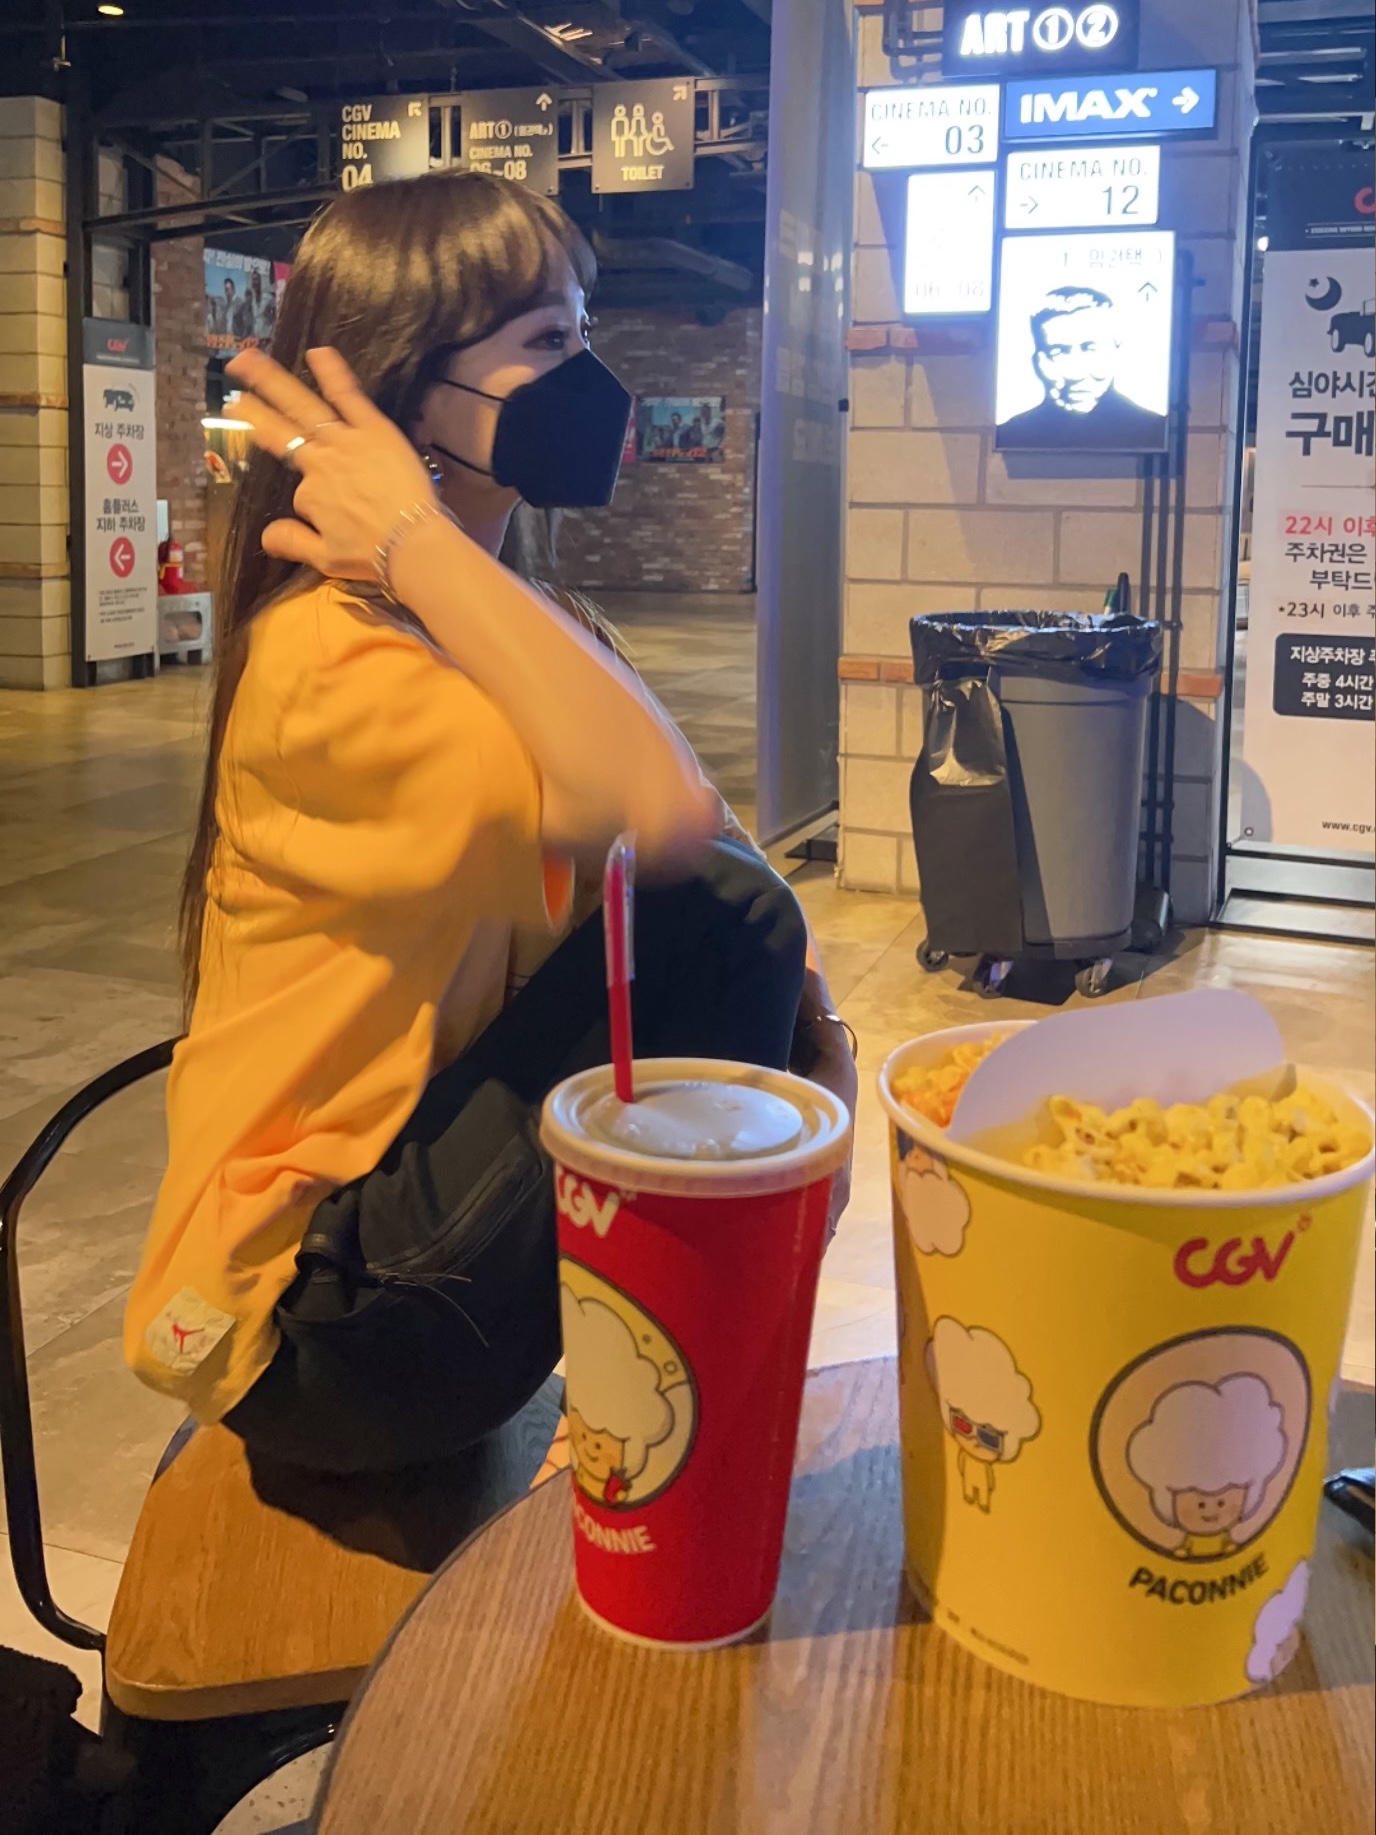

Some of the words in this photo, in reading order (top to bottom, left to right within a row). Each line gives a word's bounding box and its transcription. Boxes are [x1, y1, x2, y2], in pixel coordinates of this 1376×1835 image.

[341, 104, 372, 122] CGV
[871, 99, 949, 121] CINEMA
[959, 97, 992, 117] NO.
[1020, 88, 1155, 123] IMAX
[342, 121, 401, 141] CINEMA
[945, 125, 985, 155] 03
[342, 142, 368, 159] NO.
[469, 145, 511, 160] CINEMA
[514, 144, 534, 158] NO.
[342, 164, 373, 192] 04
[621, 165, 664, 181] TOILET
[1020, 160, 1103, 181] CINEMA
[1113, 158, 1147, 177] NO.
[1102, 185, 1139, 215] 12
[94, 422, 113, 439] 지상
[117, 423, 144, 440] 주차장
[1285, 410, 1375, 456] 구매
[103, 498, 139, 514] 홈플러스
[96, 517, 116, 533] 지하
[119, 516, 145, 532] 주차장
[1285, 516, 1332, 537] 22시
[1285, 542, 1367, 564] 주차권은
[1333, 604, 1360, 618] 이후
[1290, 645, 1366, 666] 지상주차장
[1335, 674, 1374, 691] 4시간
[1301, 692, 1330, 708] 주말
[1334, 694, 1373, 711] 3시간
[1322, 820, 1375, 834] www.cgv.
[1174, 1231, 1294, 1289] CGV
[1129, 1552, 1269, 1606] PACONNIE
